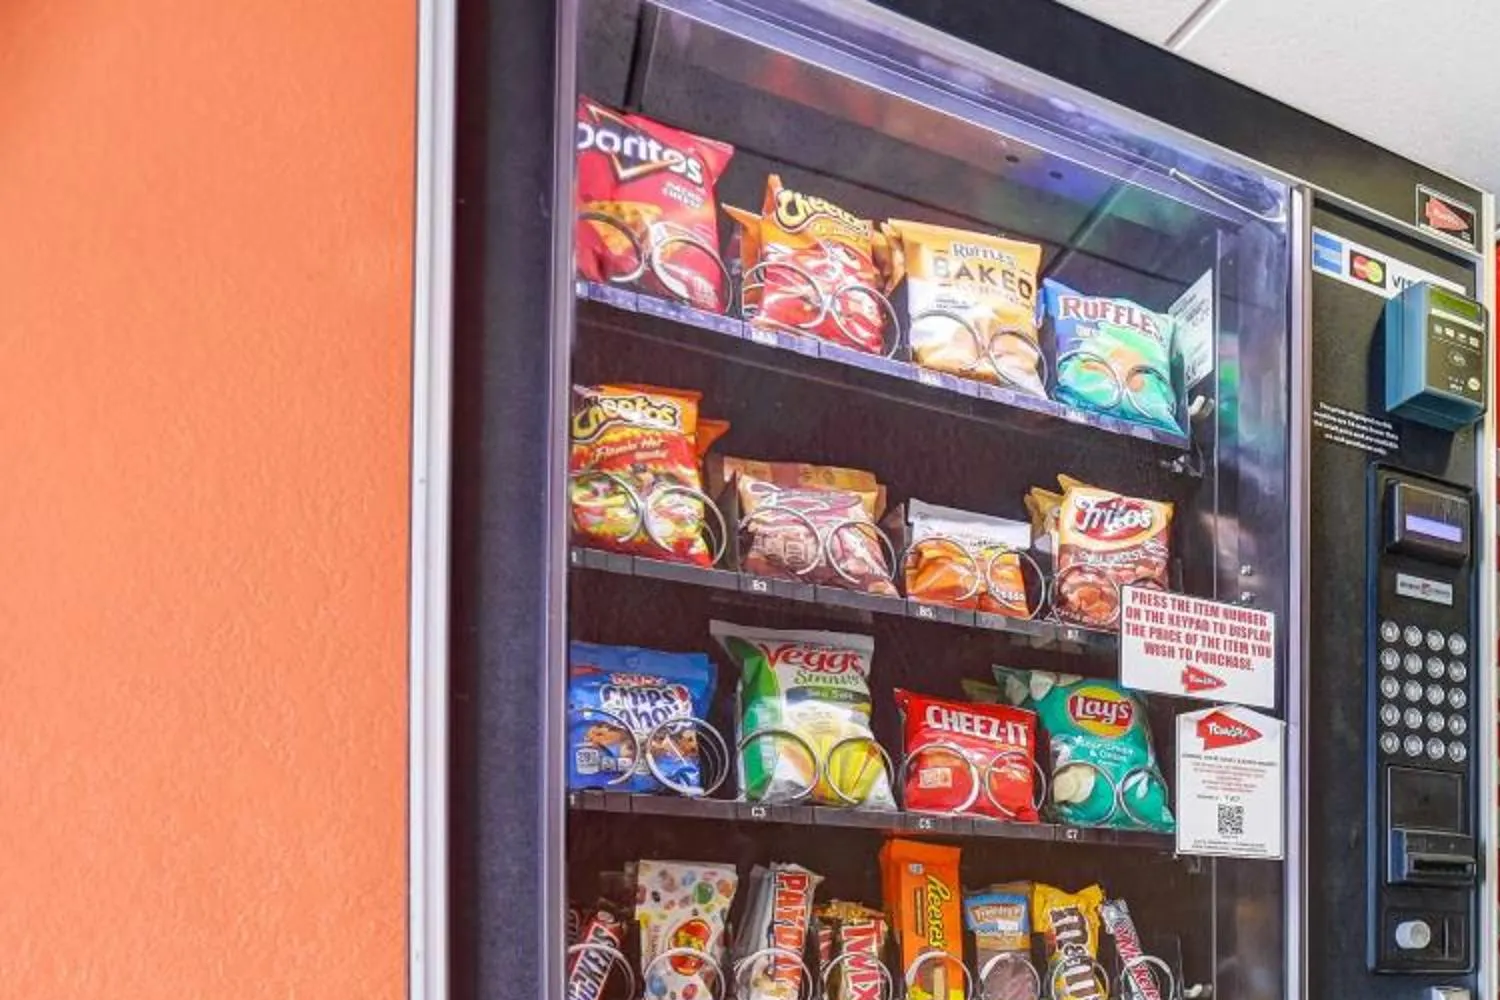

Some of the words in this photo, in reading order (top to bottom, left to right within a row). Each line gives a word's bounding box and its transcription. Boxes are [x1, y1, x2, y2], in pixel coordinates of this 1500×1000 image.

[934, 256, 1034, 302] BAKED
[1075, 496, 1153, 533] Fritos
[1125, 606, 1141, 619] ON
[1144, 609, 1165, 623] THE
[1168, 613, 1209, 632] KEYPAD
[1212, 621, 1227, 634] TO
[1229, 624, 1272, 642] DISPLAY
[1131, 591, 1168, 608] PRESS
[1171, 598, 1191, 612] THE
[1194, 602, 1220, 618] ITEM
[1223, 607, 1267, 627] NUMBER
[1125, 622, 1147, 637] THE
[1149, 627, 1182, 643] PRICE
[1185, 632, 1198, 645] OF
[1201, 636, 1221, 650] THE
[1223, 639, 1249, 654] ITEM
[1251, 643, 1272, 658] YOU
[1144, 641, 1175, 659] WISH
[1178, 647, 1194, 661] TO
[925, 705, 1028, 746] CHEEZ-IT
